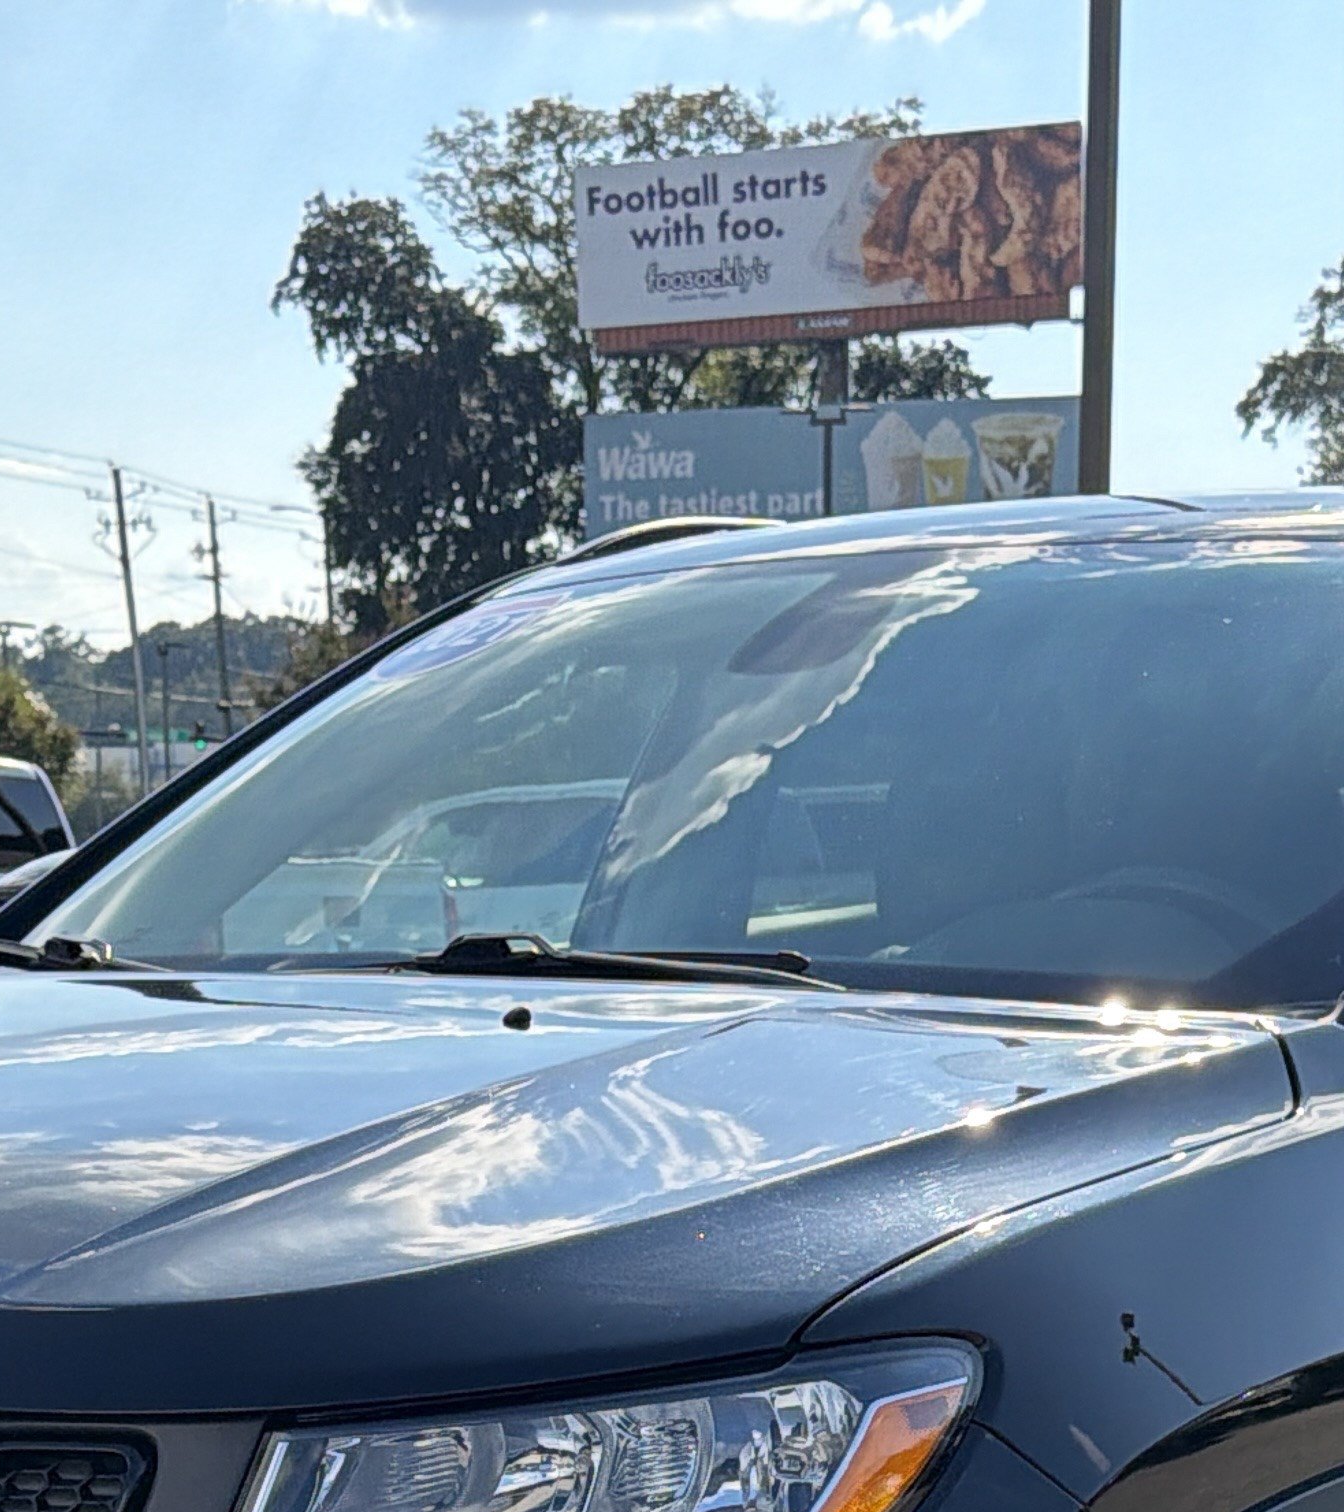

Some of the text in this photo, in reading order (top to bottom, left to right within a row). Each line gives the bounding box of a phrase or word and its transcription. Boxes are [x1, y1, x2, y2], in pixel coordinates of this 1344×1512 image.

[586, 170, 827, 216] Football starts
[629, 208, 784, 249] with foo.
[598, 447, 695, 481] Wawa
[599, 490, 650, 521] The
[659, 487, 760, 517] tastiest
